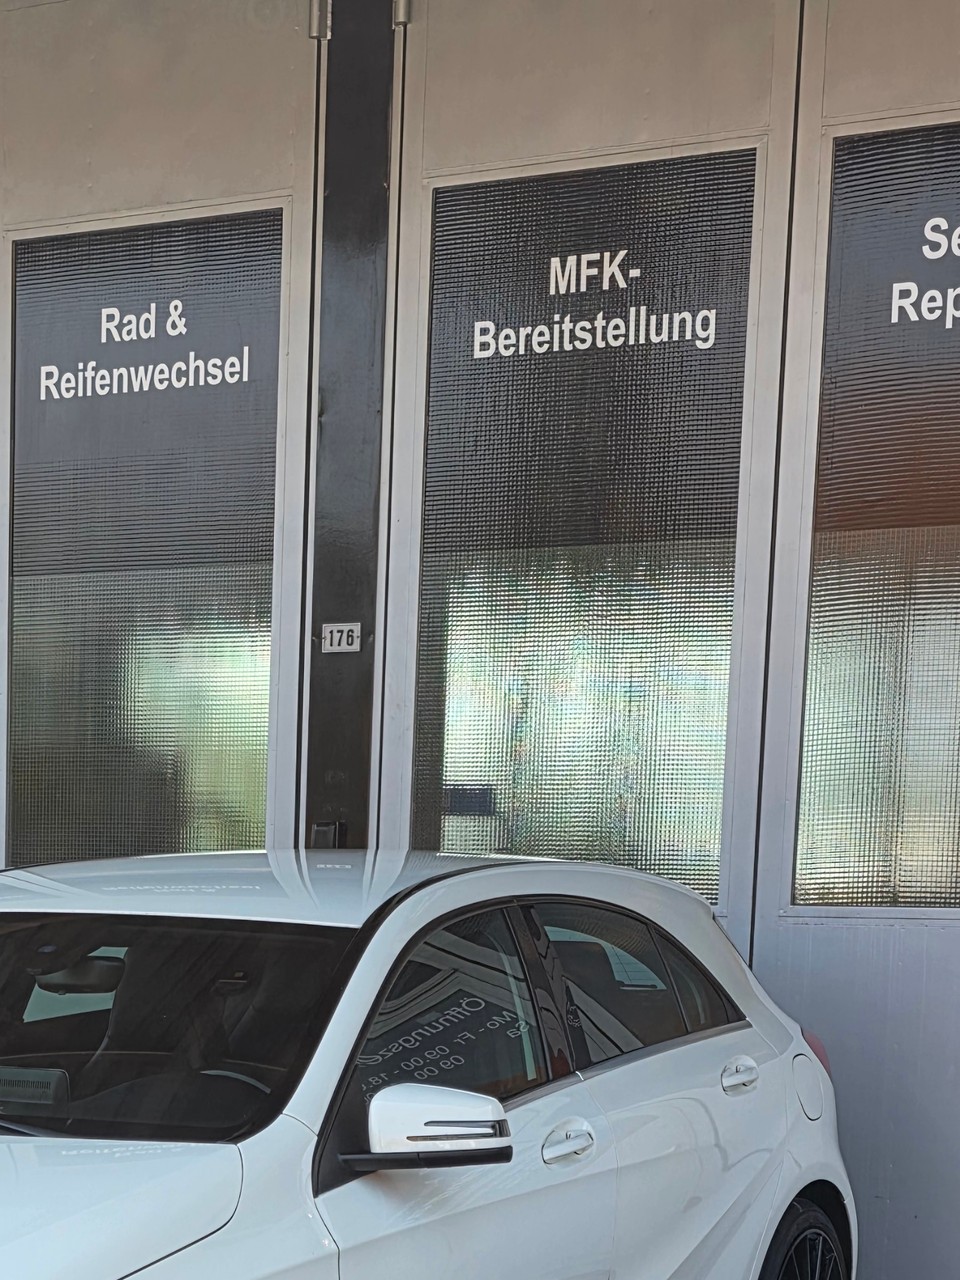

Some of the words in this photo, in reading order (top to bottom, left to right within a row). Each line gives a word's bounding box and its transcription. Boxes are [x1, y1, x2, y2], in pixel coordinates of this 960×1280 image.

[548, 249, 642, 296] MFK-
[100, 303, 157, 344] Rad
[165, 299, 188, 337] &
[472, 305, 718, 360] Bereitstellung
[39, 346, 251, 401] Reifenwechsel
[328, 628, 355, 648] 176
